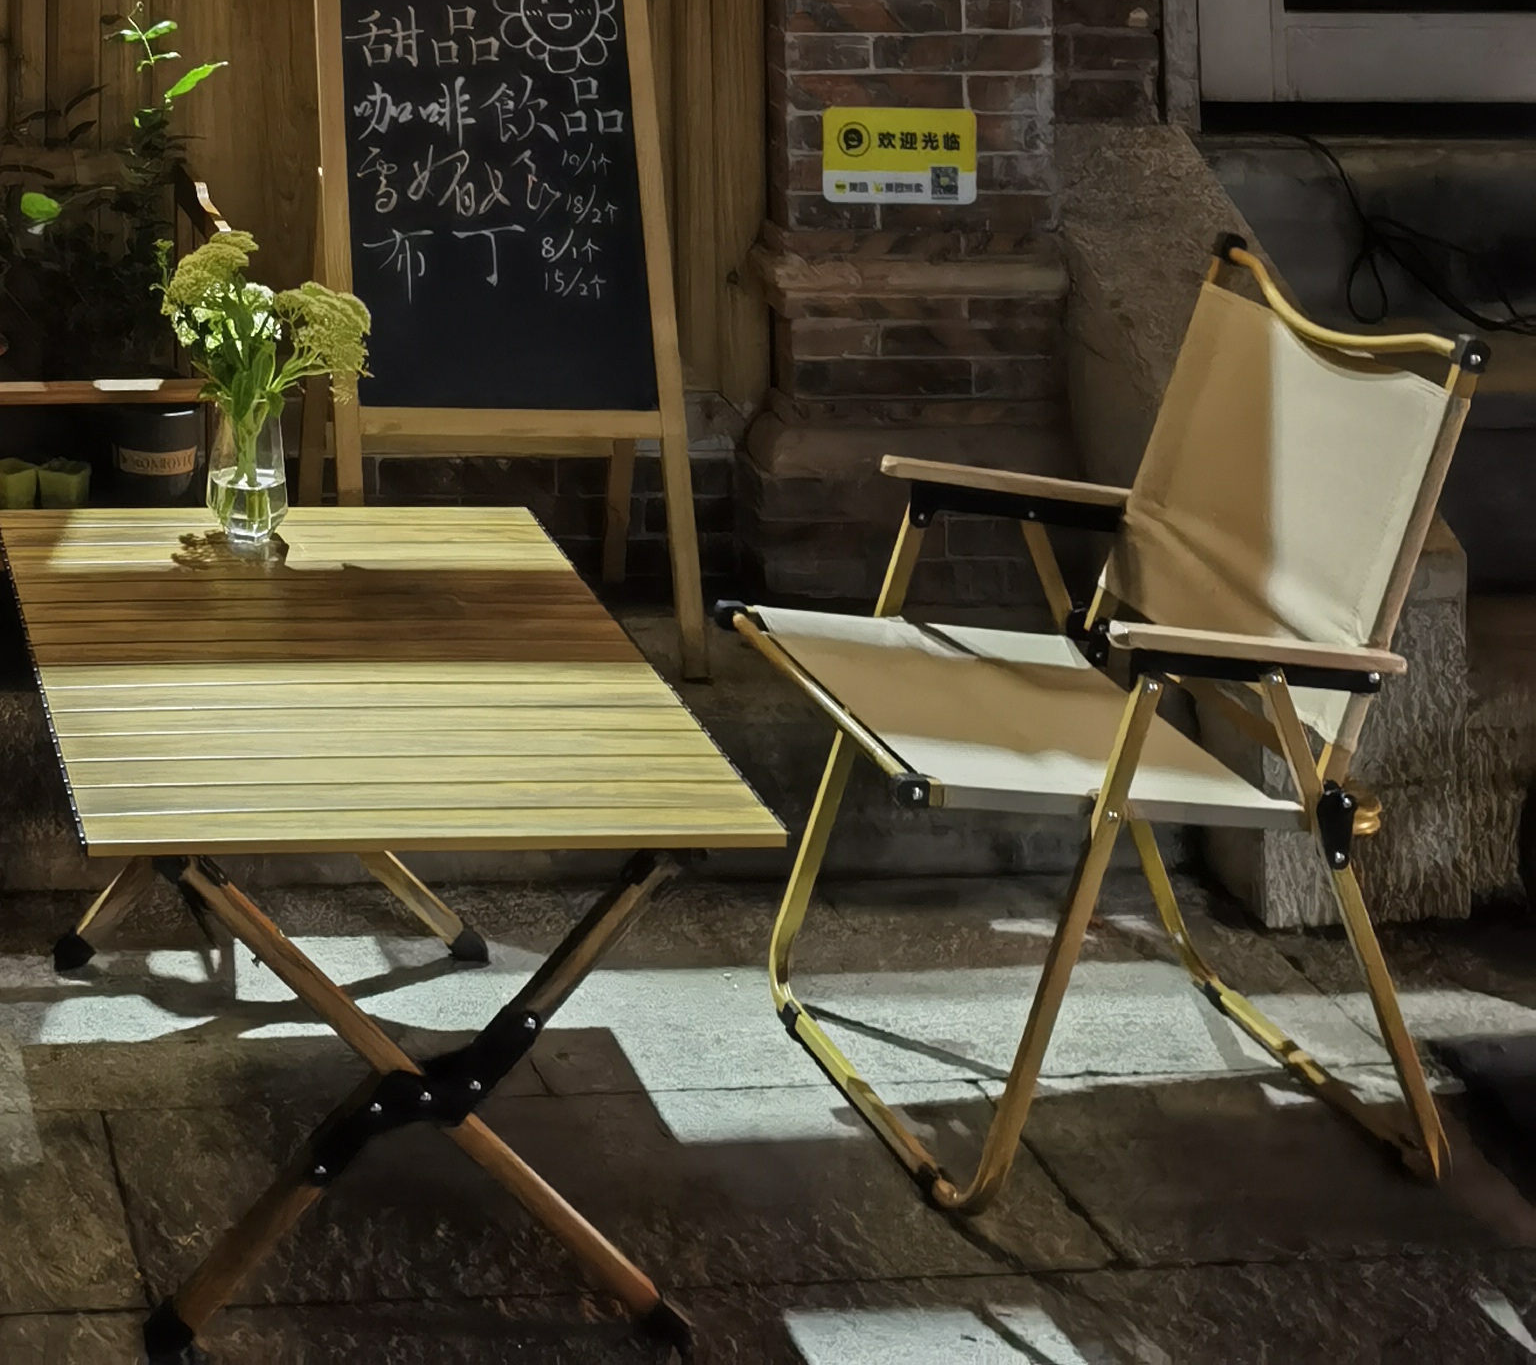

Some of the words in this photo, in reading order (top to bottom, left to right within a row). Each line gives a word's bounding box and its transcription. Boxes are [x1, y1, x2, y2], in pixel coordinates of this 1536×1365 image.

[345, 4, 500, 67] 甜品
[353, 74, 624, 148] 咖啡飲品
[877, 131, 961, 152] 欢迎光临
[363, 224, 526, 305] 布丁
